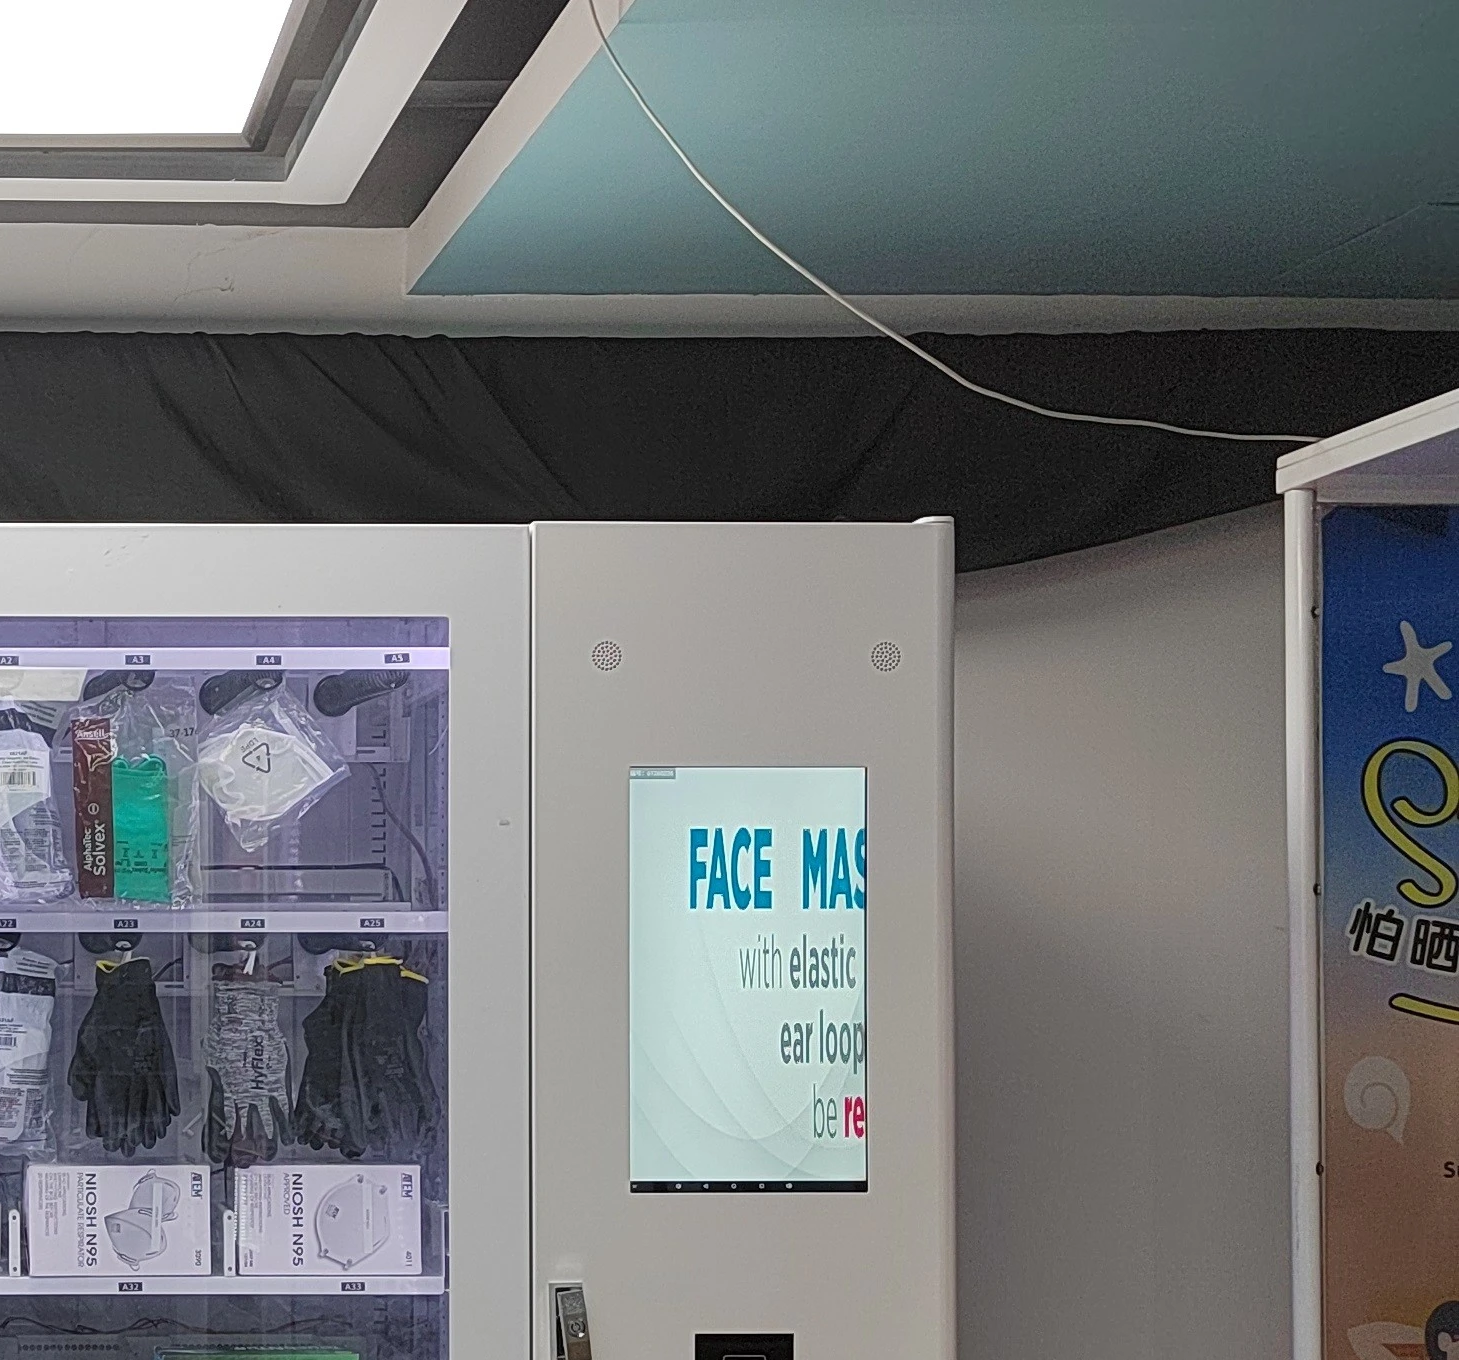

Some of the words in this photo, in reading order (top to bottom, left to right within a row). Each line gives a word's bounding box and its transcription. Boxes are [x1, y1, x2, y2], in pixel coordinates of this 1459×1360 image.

[76, 728, 106, 738] Ansell
[689, 828, 773, 910] FACE
[739, 935, 783, 989] with
[789, 934, 857, 989] elastic
[780, 1022, 815, 1064] ear
[820, 1008, 865, 1075] loop
[813, 1083, 838, 1139] be
[844, 1096, 865, 1139] re
[77, 1172, 85, 1220] PARTICULATE
[85, 1173, 97, 1228] NIOSH
[283, 1172, 291, 1215] APPROVED
[292, 1173, 304, 1228] NIOSH
[401, 1172, 412, 1198] ATEM
[77, 1222, 85, 1268] RESPIRATOR
[85, 1230, 97, 1267] N95
[292, 1233, 304, 1267] N95
